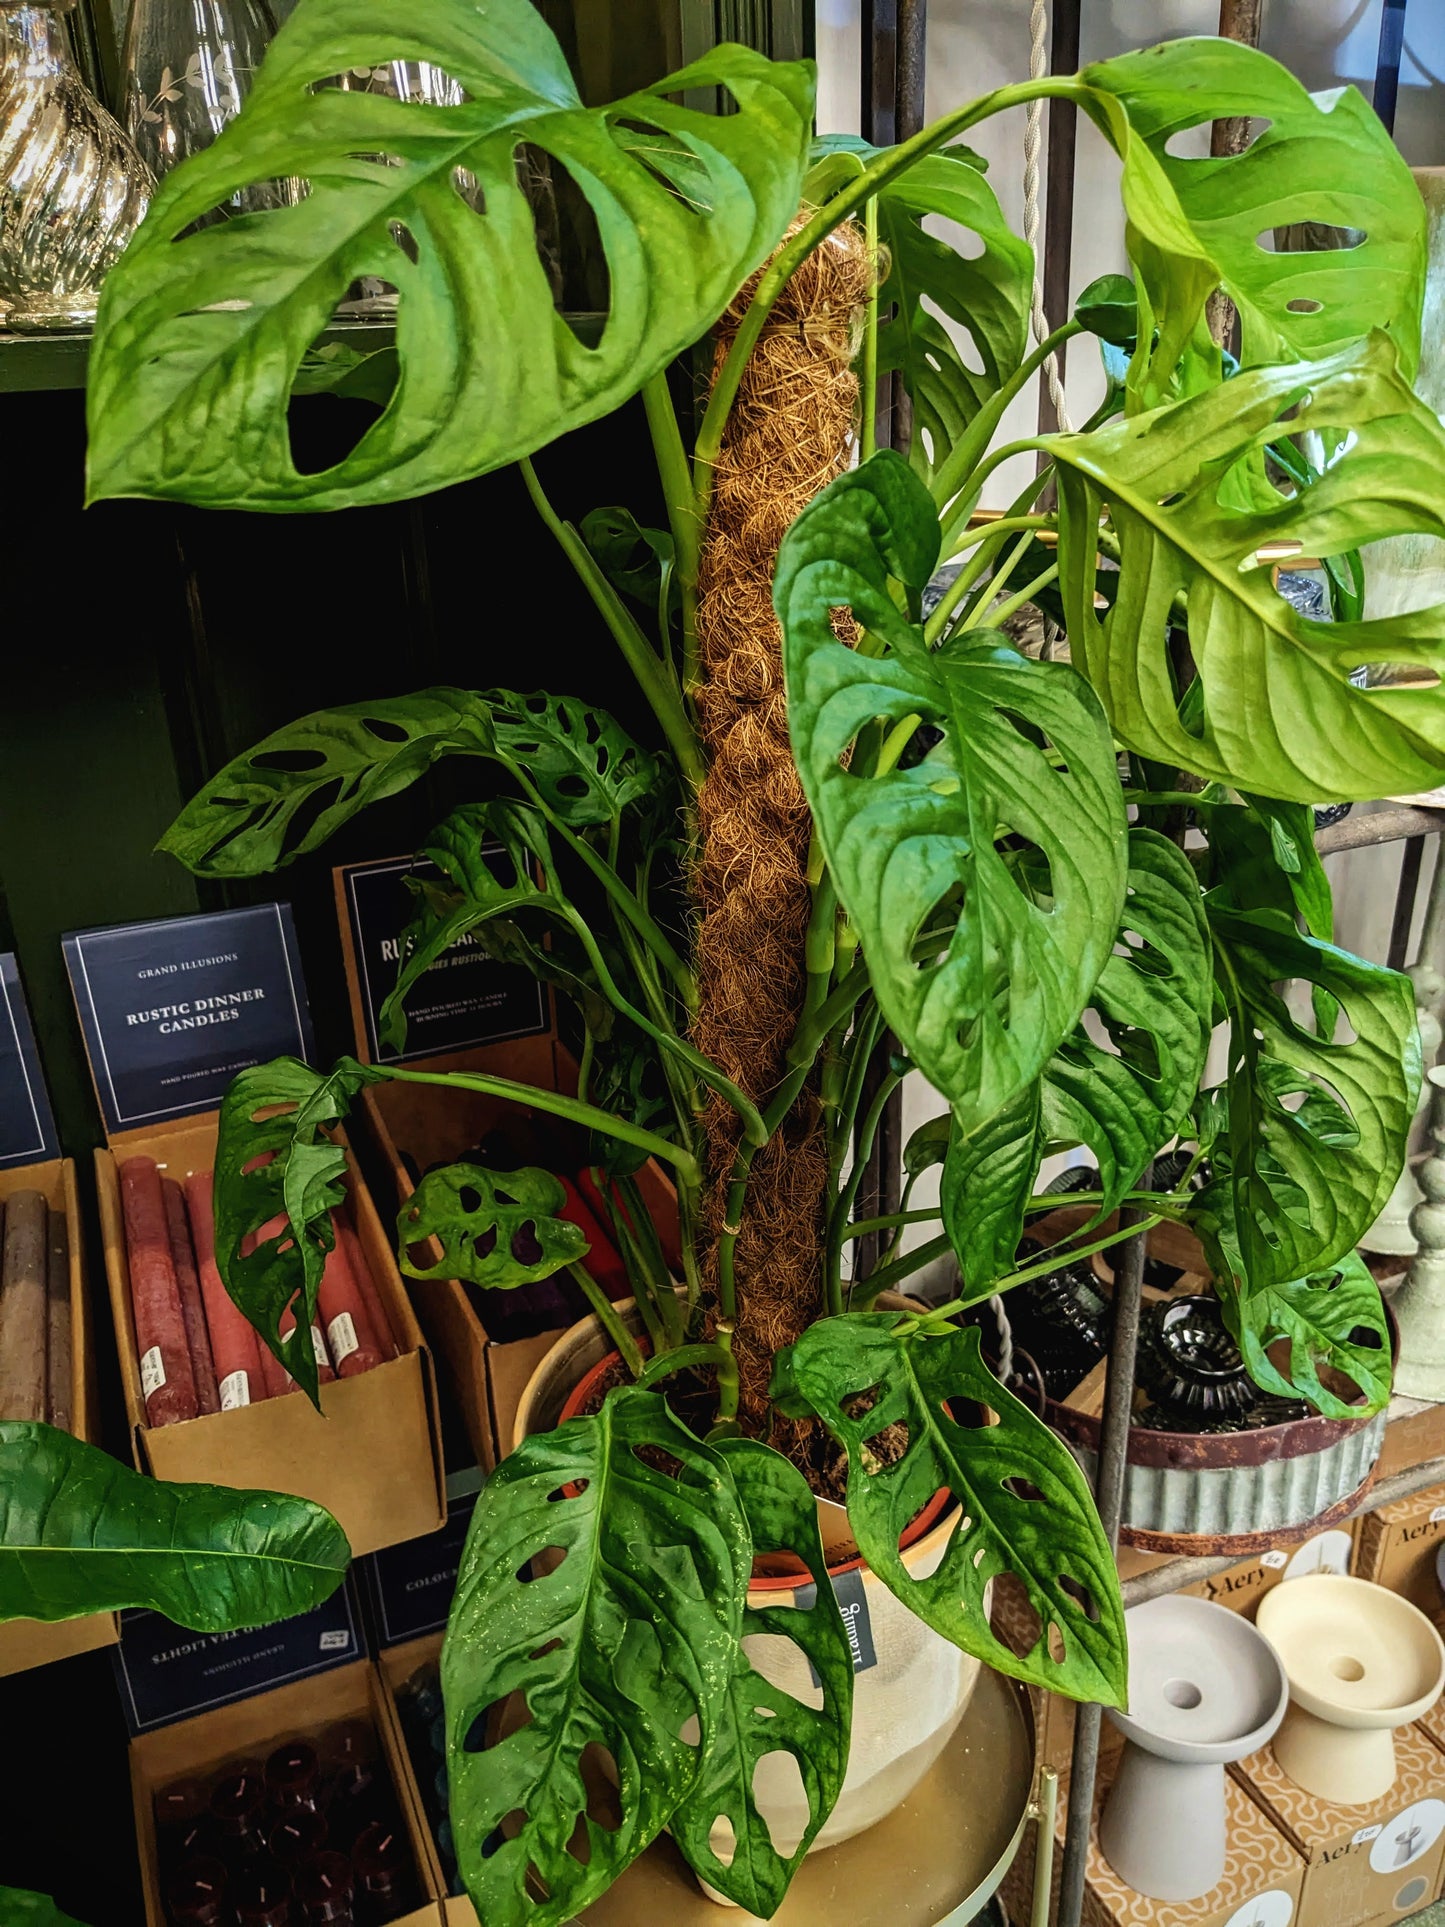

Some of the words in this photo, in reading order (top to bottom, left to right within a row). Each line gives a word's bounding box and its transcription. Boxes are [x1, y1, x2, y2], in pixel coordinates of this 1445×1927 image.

[138, 964, 178, 979] GRAND
[181, 953, 238, 971] ILLUSIONS
[126, 1003, 191, 1026] RUSTIC
[194, 988, 265, 1012] DINNER
[159, 1008, 240, 1034] CANDLES
[160, 1075, 181, 1086] HAND
[182, 1070, 210, 1081] POURED
[1395, 1520, 1441, 1546] Aery
[1218, 1567, 1266, 1597] Aery
[151, 1640, 208, 1664] LIGHTS
